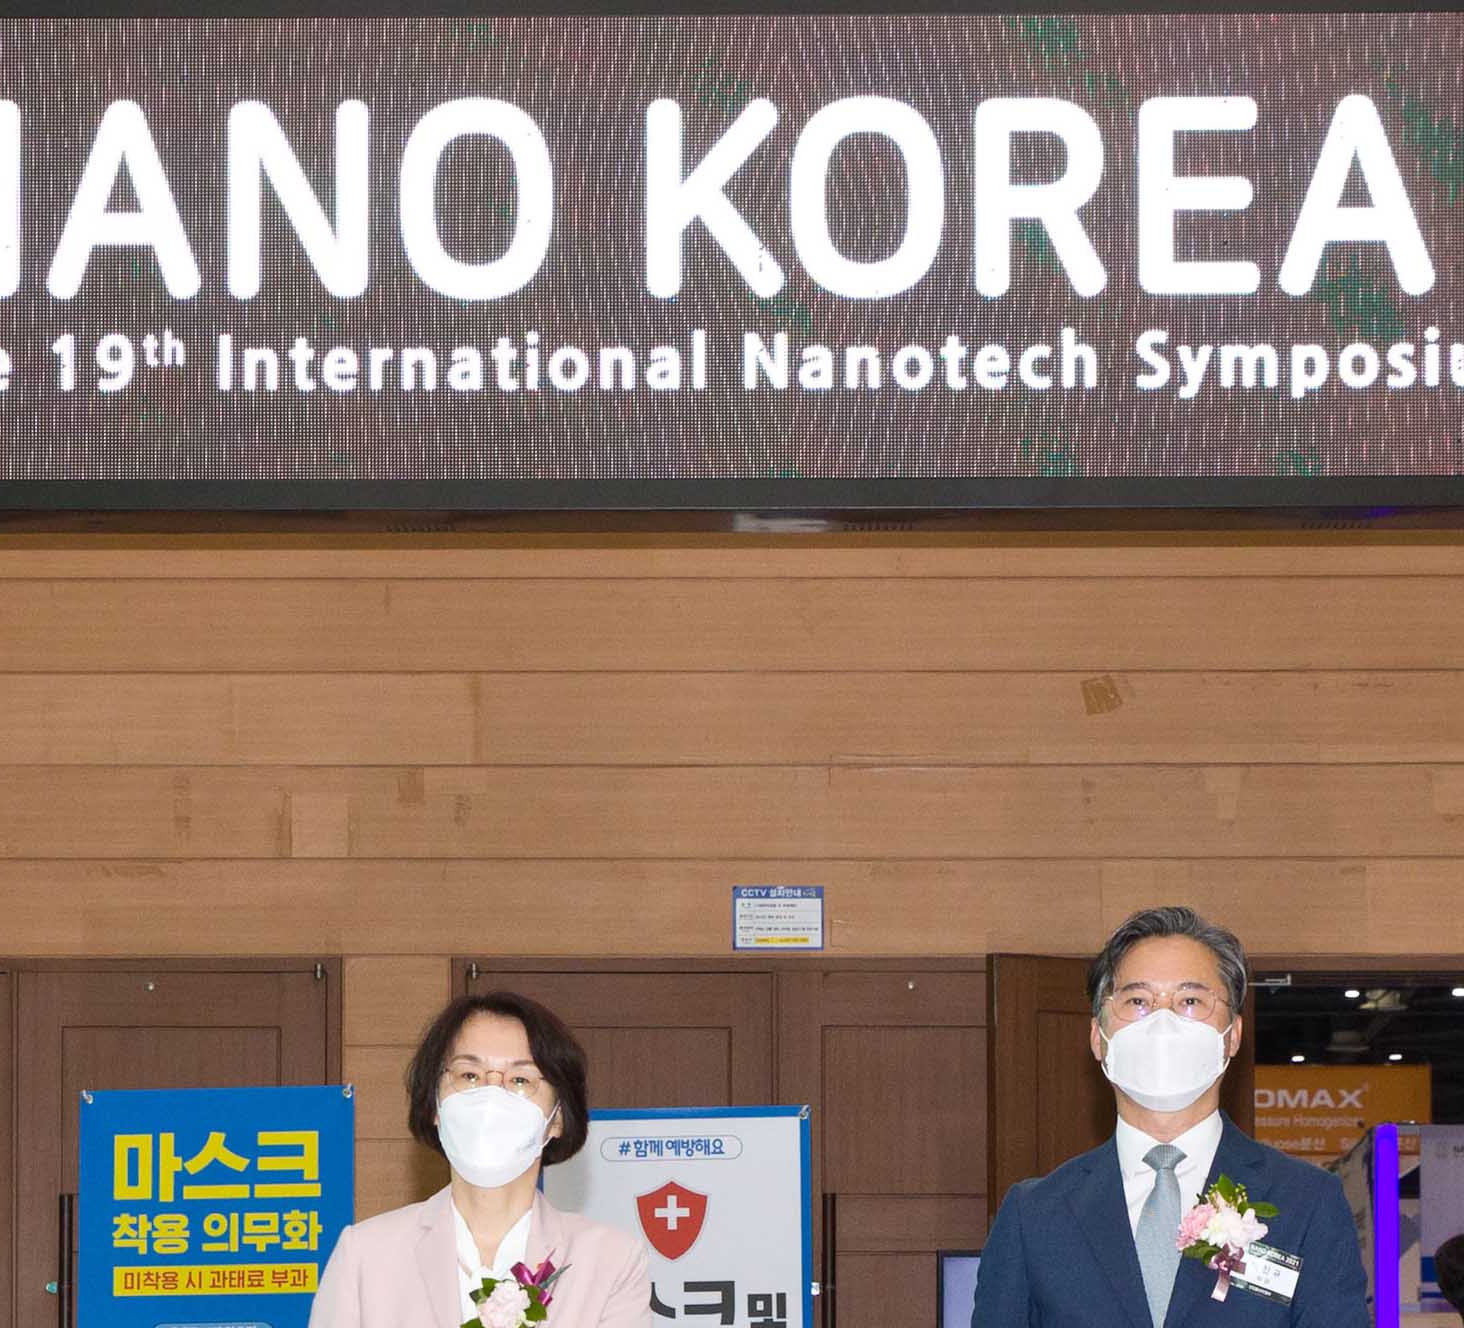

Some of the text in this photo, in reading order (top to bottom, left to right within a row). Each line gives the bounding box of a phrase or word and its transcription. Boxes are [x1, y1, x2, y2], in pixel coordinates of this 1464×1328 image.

[645, 94, 1435, 300] KOREA
[50, 329, 186, 391] 19th
[218, 329, 706, 391] International
[754, 326, 1098, 391] Nanotech
[741, 889, 767, 897] CCTV
[113, 1131, 322, 1202] 마스크
[112, 1210, 323, 1255] 착용 의무화
[123, 1269, 309, 1290] 미착용 시 과태료 부과
